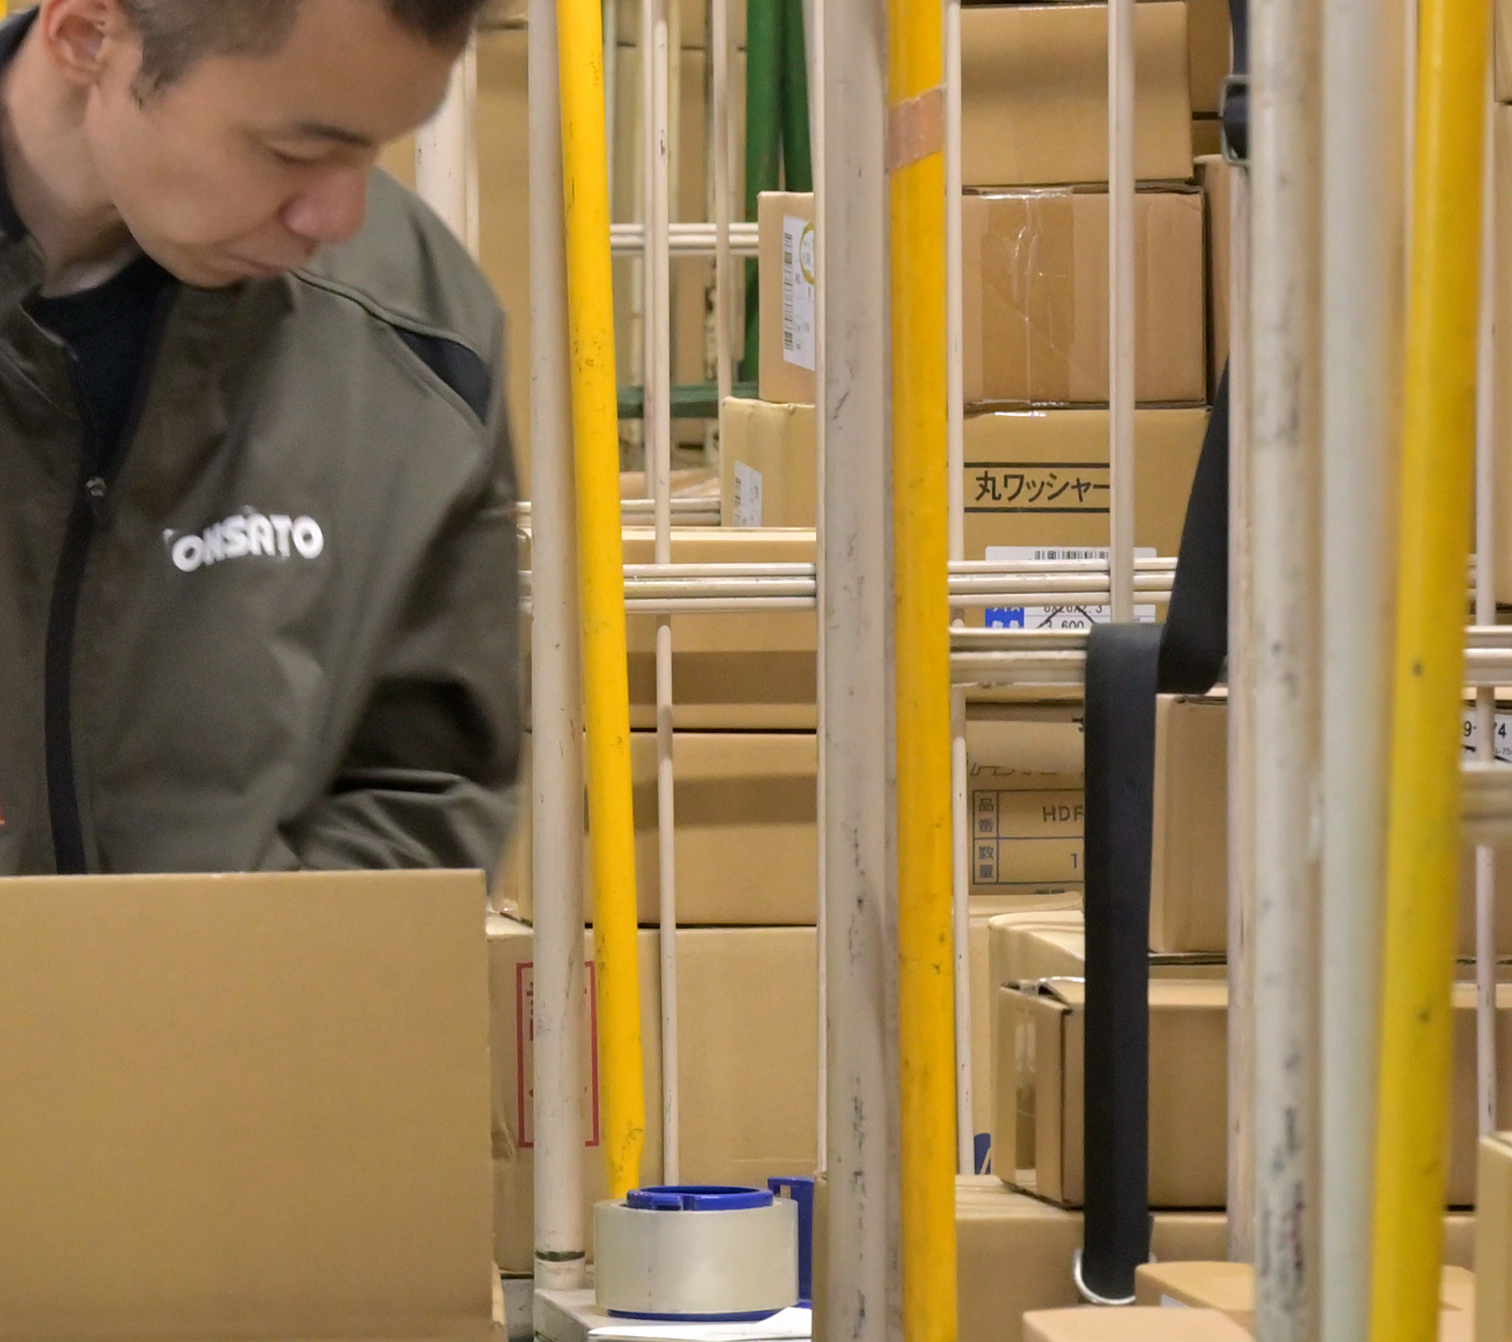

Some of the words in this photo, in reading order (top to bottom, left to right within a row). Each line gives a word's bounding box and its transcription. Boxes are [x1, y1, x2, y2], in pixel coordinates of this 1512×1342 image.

[975, 470, 1111, 503] 丸ワッシャー
[171, 510, 325, 574] OHSATO
